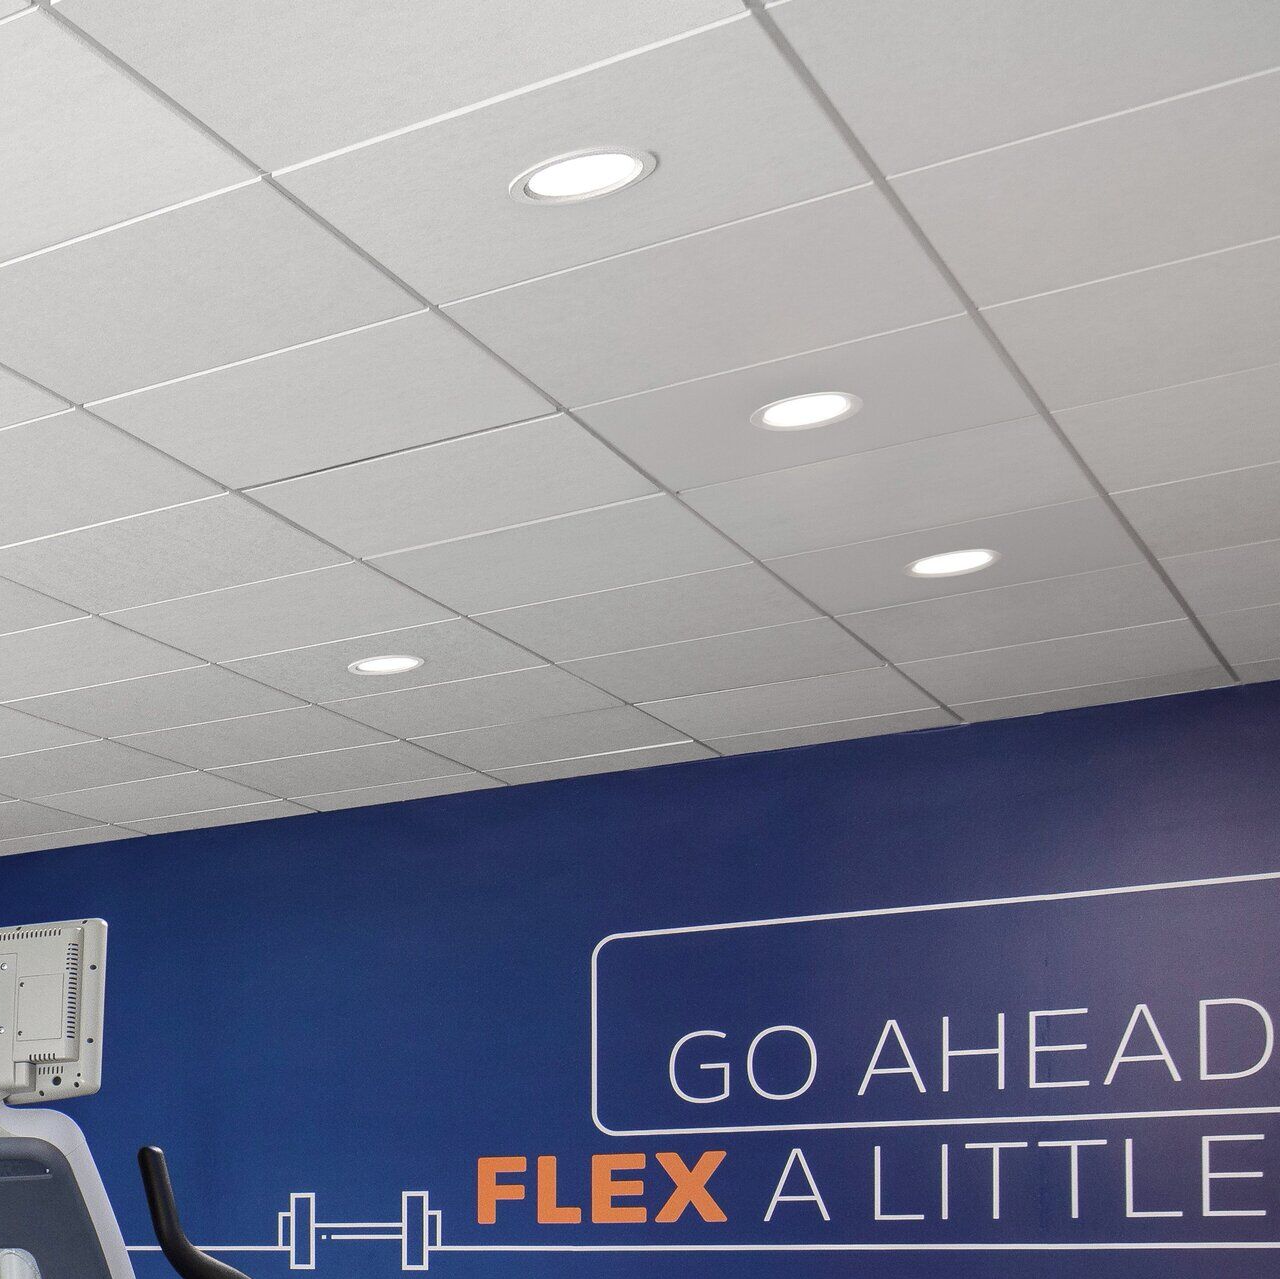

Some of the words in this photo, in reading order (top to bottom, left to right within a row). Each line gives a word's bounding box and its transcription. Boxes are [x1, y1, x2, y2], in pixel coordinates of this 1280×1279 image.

[668, 1025, 818, 1104] GO
[857, 997, 1276, 1096] AHEAD
[477, 1149, 729, 1225] FLEX
[763, 1148, 831, 1222] A
[874, 1134, 1268, 1221] LITTLE
